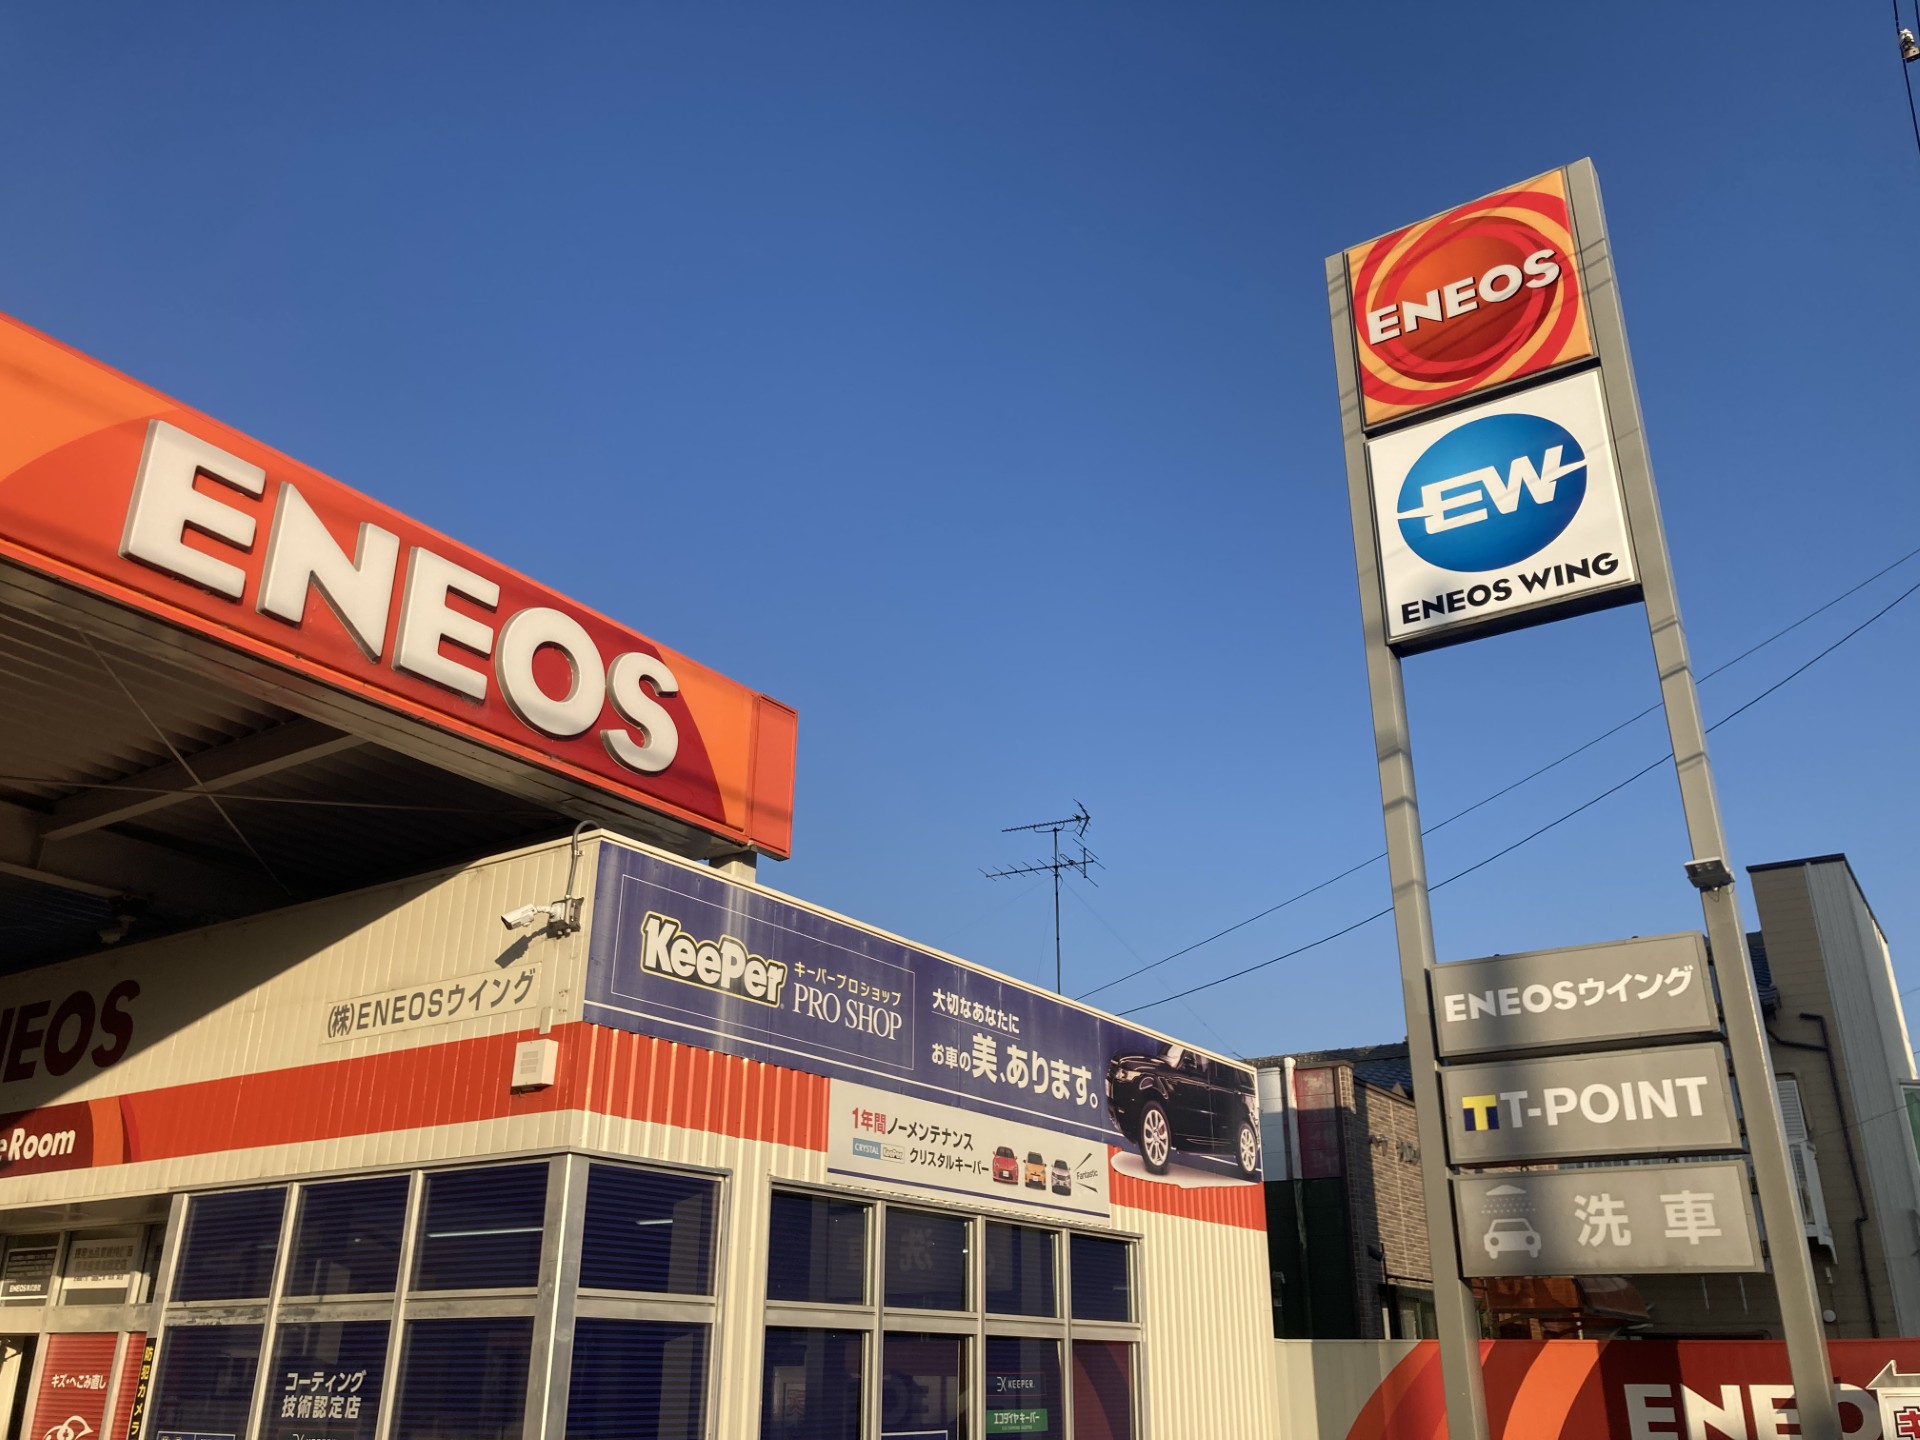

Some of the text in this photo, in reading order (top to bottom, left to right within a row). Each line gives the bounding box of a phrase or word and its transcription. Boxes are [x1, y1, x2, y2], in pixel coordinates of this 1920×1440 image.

[1367, 248, 1561, 345] ENEOS
[1410, 445, 1578, 535] EW
[118, 419, 679, 778] ENEOS
[1401, 552, 1619, 624] ENEOS WING
[642, 912, 787, 1006] KeePer
[328, 968, 536, 1038] (株)ENEOSウイング
[792, 982, 902, 1040] PRO SHOP
[932, 988, 1020, 1034] 大切なあなたに
[1444, 964, 1694, 1022] ENEOSウイング
[931, 1033, 1099, 1109] お車の美、あります。
[852, 1107, 974, 1151] 1年間ノーメンテナンス
[1500, 1076, 1708, 1129] T-POINT
[854, 1143, 879, 1155] CRYSTAL
[909, 1147, 990, 1174] クリスタルキーパー
[1076, 1169, 1099, 1181] Fantastic
[1574, 1190, 1722, 1246] 洗車
[281, 1395, 362, 1419] 技術認定店
[285, 1369, 367, 1393] コーティング
